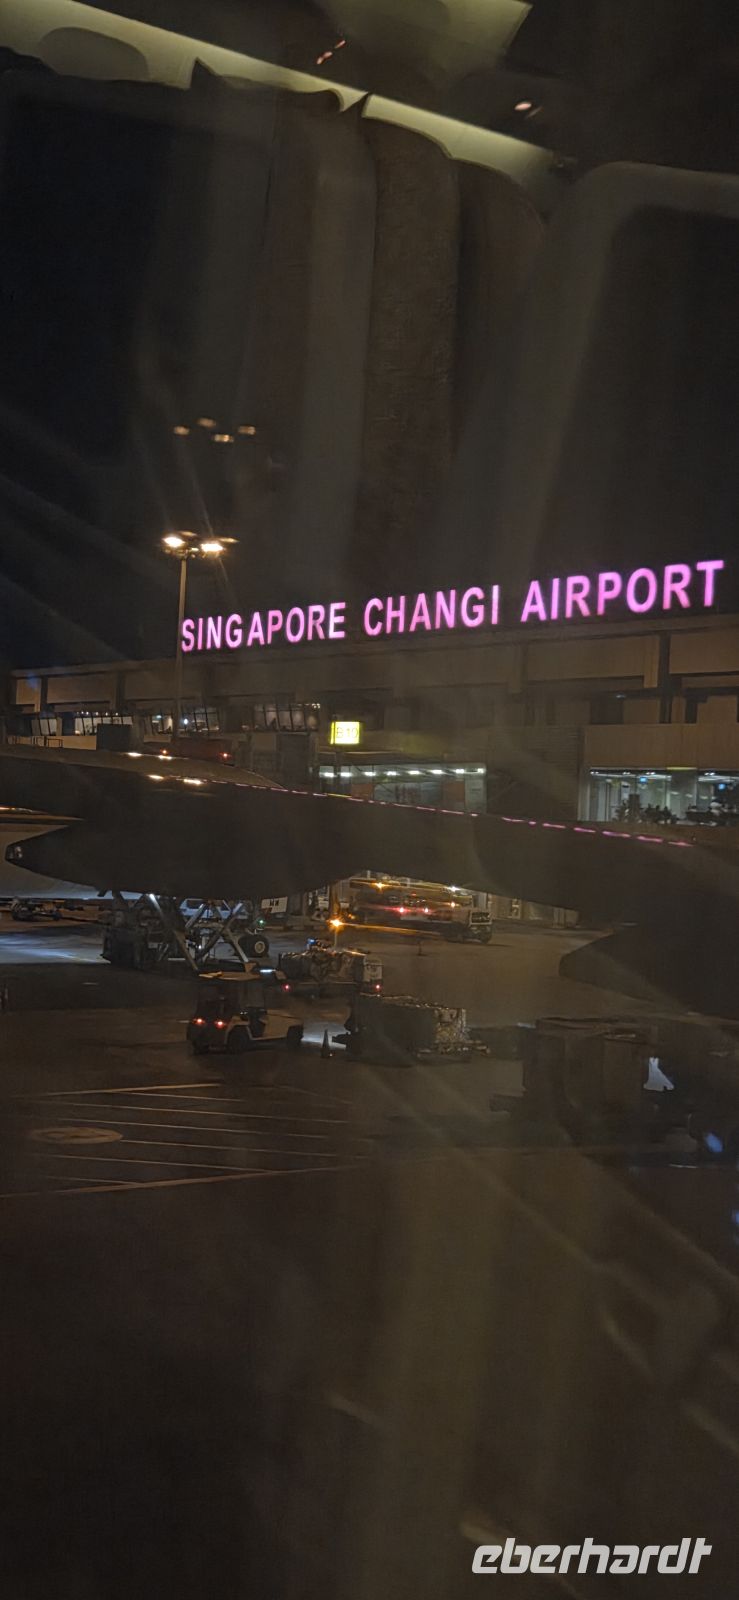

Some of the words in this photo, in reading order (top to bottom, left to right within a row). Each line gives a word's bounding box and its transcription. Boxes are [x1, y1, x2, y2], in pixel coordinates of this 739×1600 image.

[181, 602, 346, 651] SINGAPORE
[363, 585, 500, 636] CHANGI
[520, 559, 725, 622] AIRPORT
